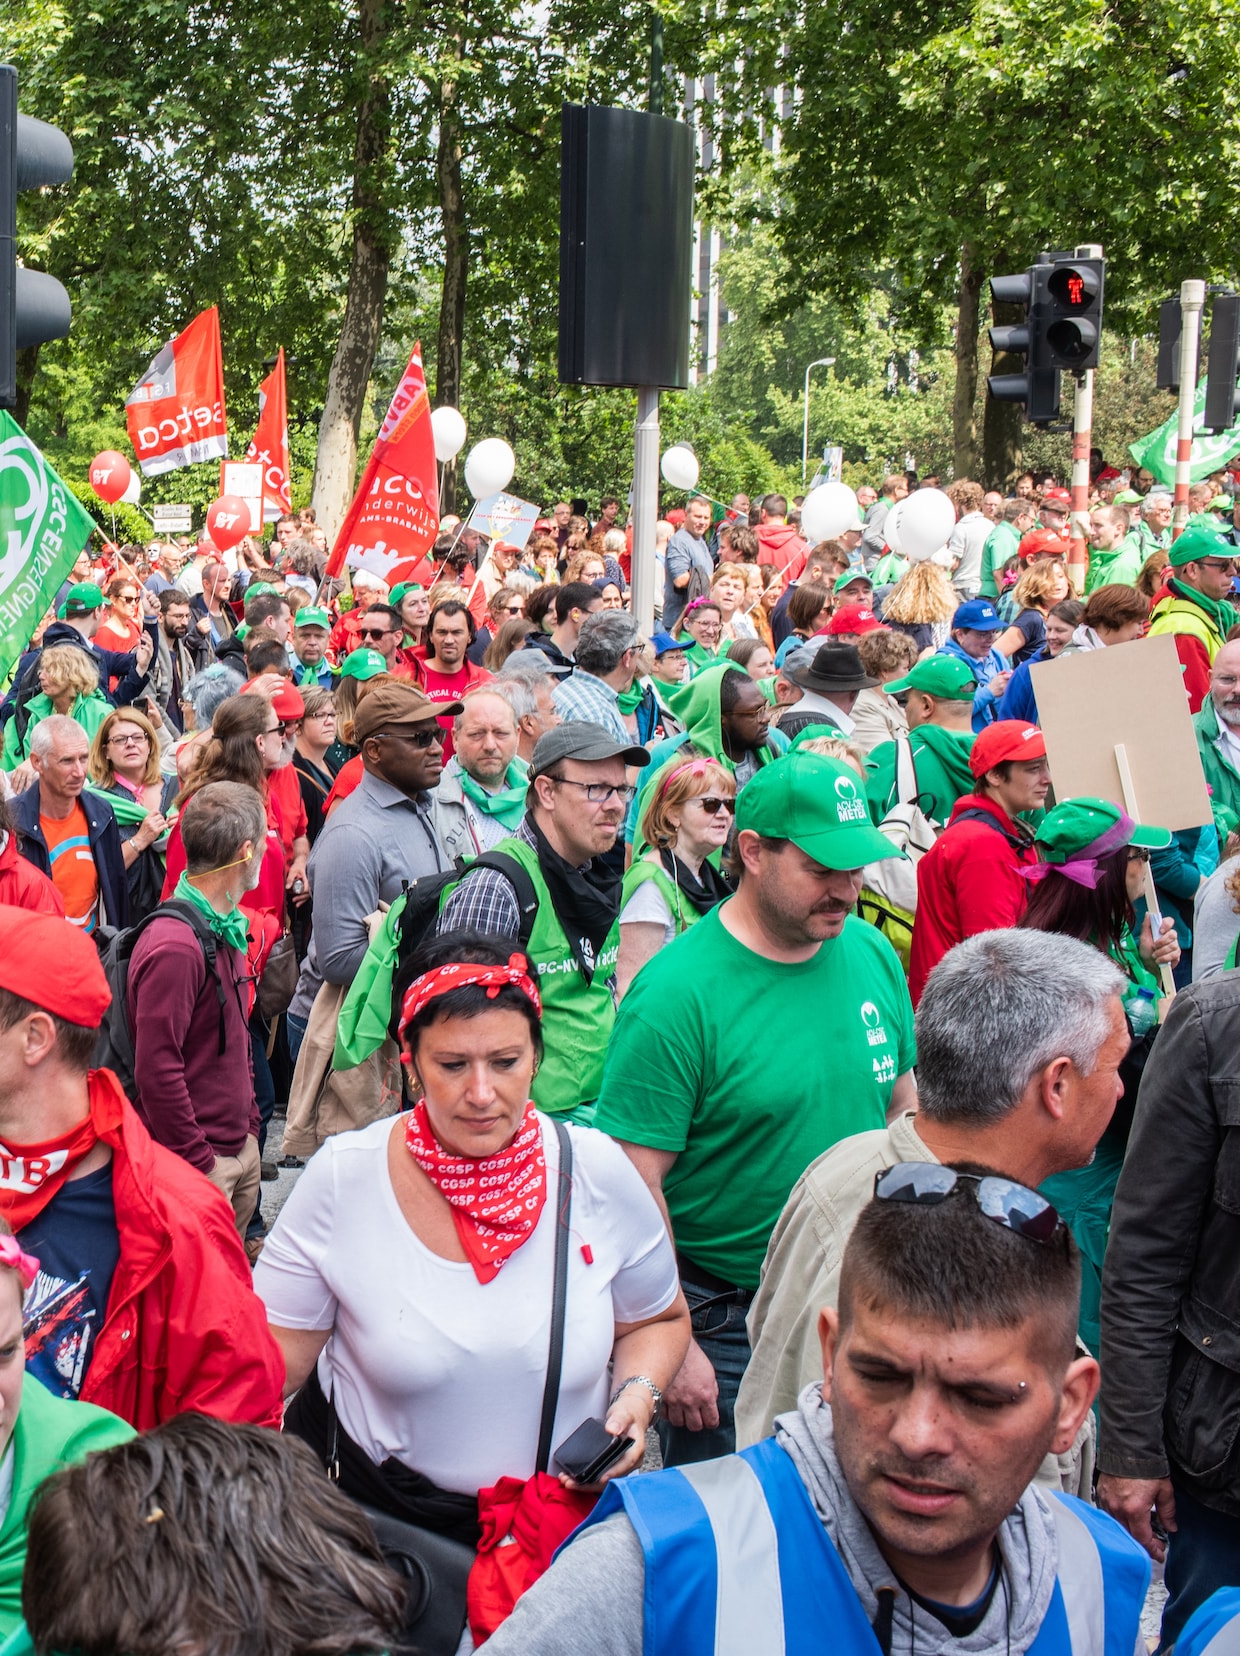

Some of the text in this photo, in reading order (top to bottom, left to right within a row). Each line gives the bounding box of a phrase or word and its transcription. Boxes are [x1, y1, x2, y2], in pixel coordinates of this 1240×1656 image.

[437, 1163, 475, 1175] CGSP
[478, 1156, 513, 1172] CGSP
[440, 1163, 535, 1192] CGSP CGSP CGSP
